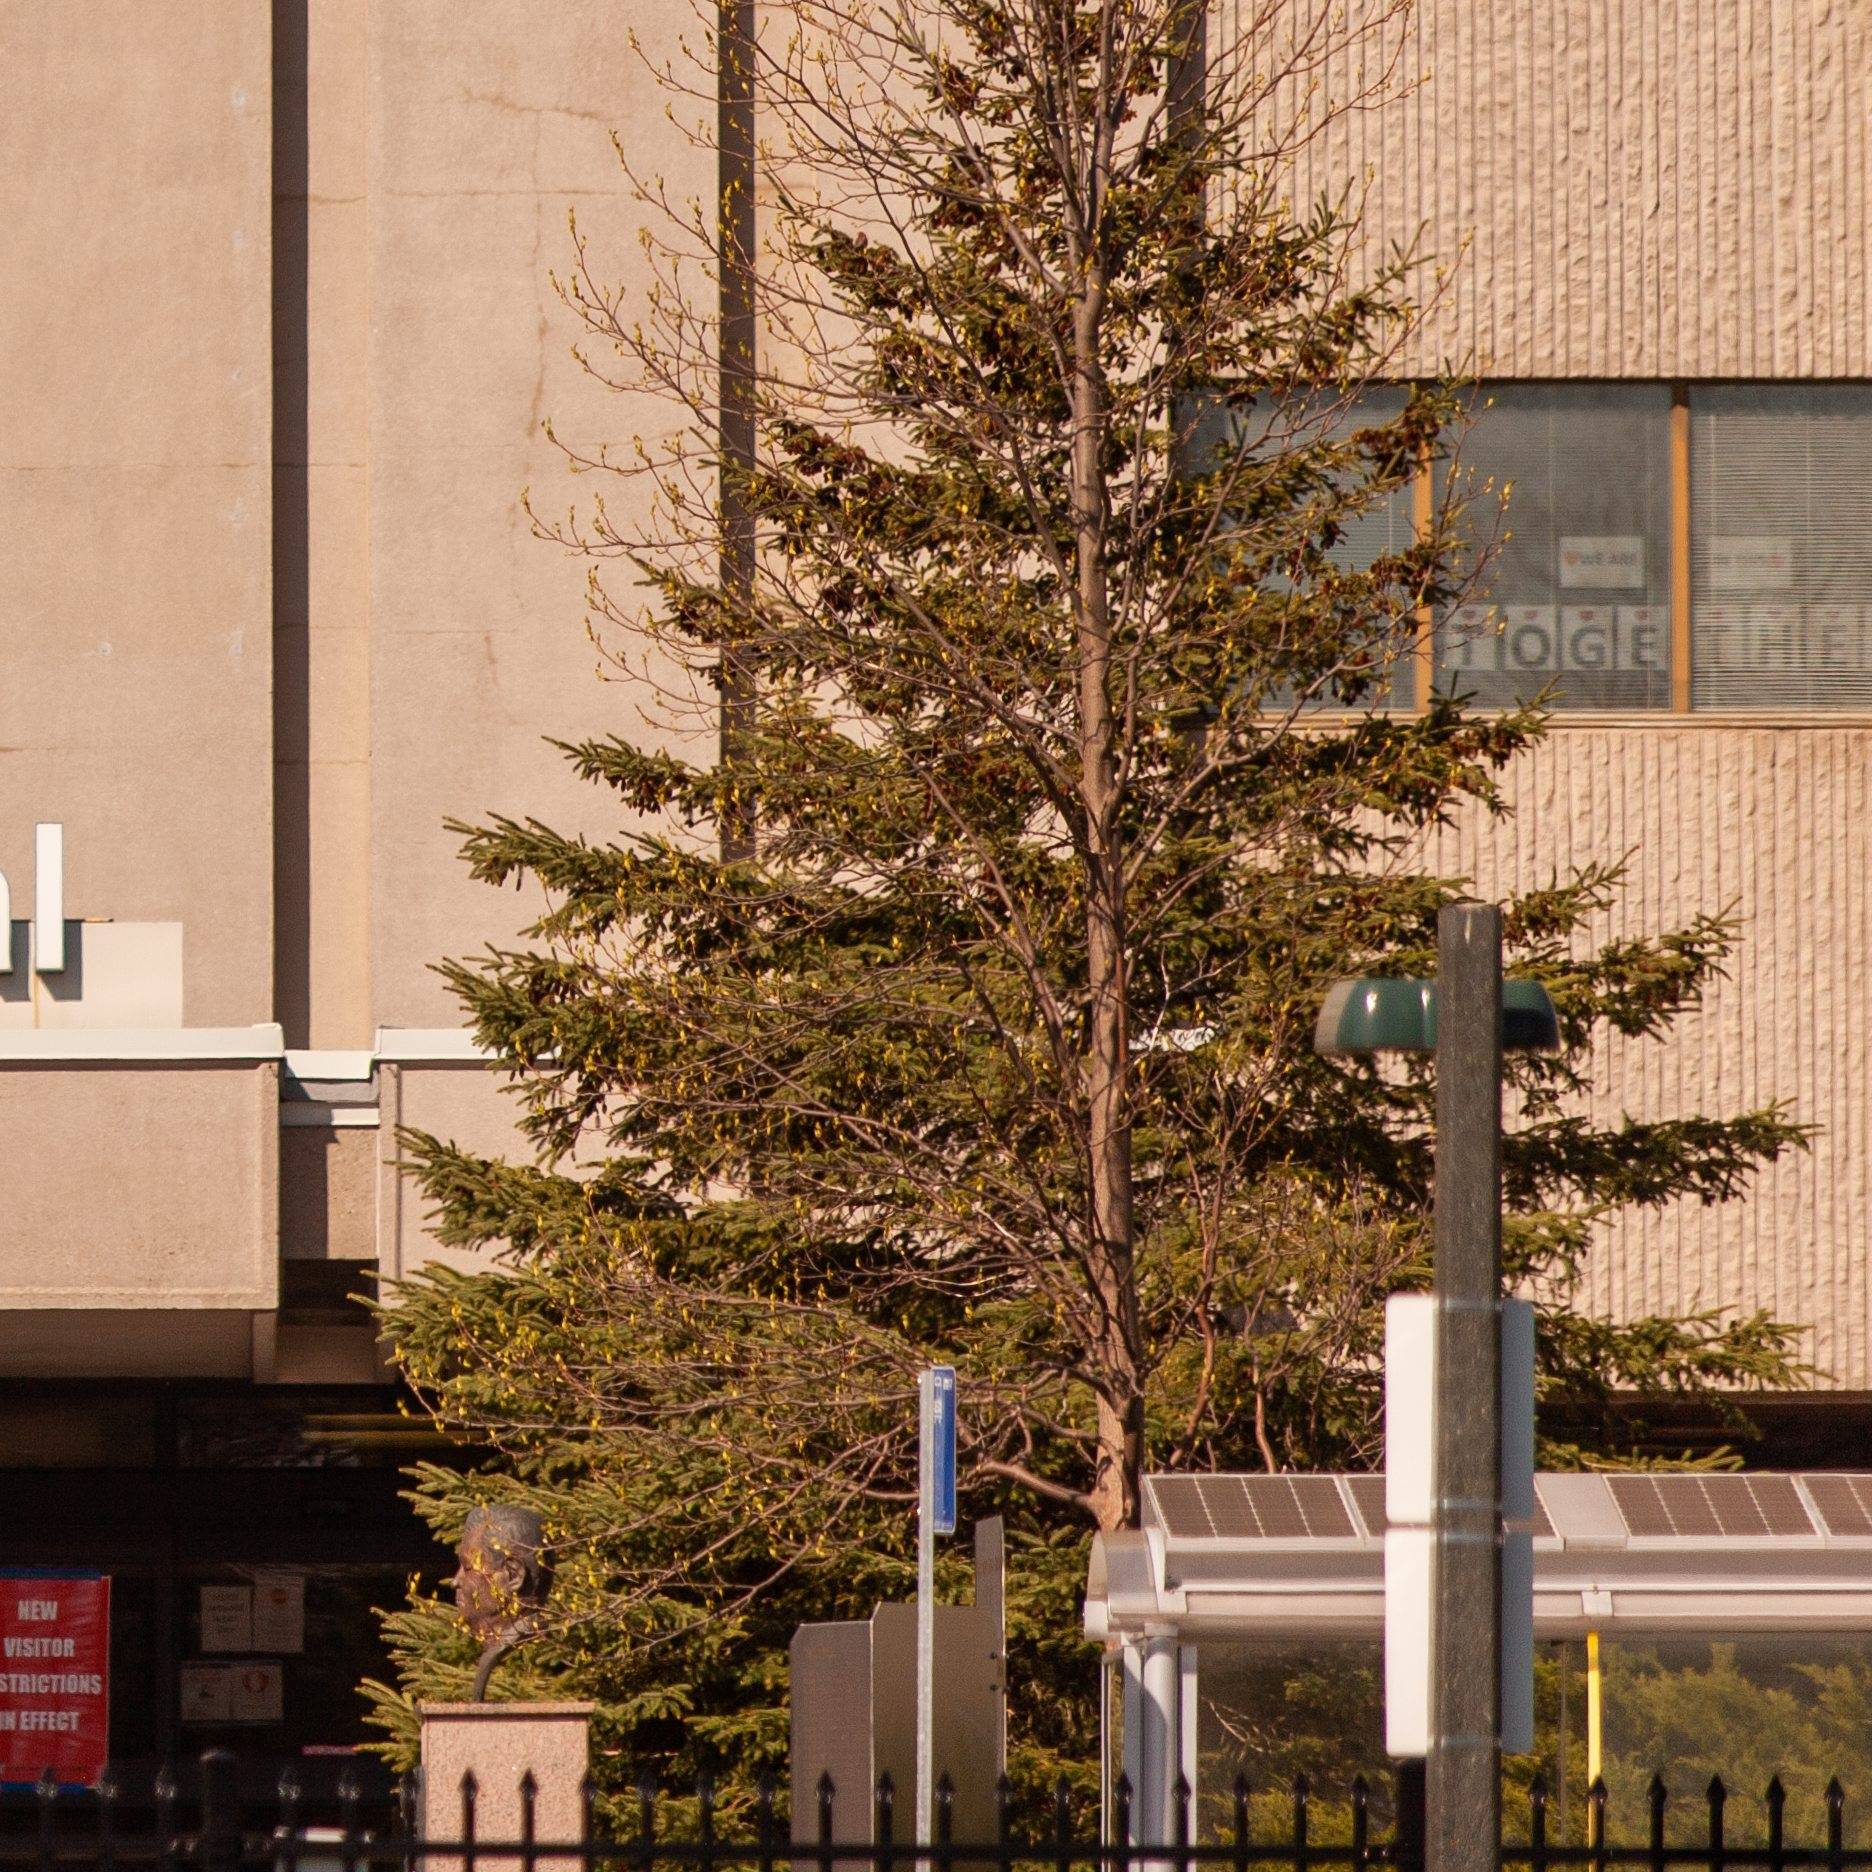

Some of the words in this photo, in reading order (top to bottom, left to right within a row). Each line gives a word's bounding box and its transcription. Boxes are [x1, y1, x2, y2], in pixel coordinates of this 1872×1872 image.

[17, 1600, 59, 1621] NEW
[3, 1637, 76, 1658] VISITOR
[19, 1711, 80, 1731] EFFECT
